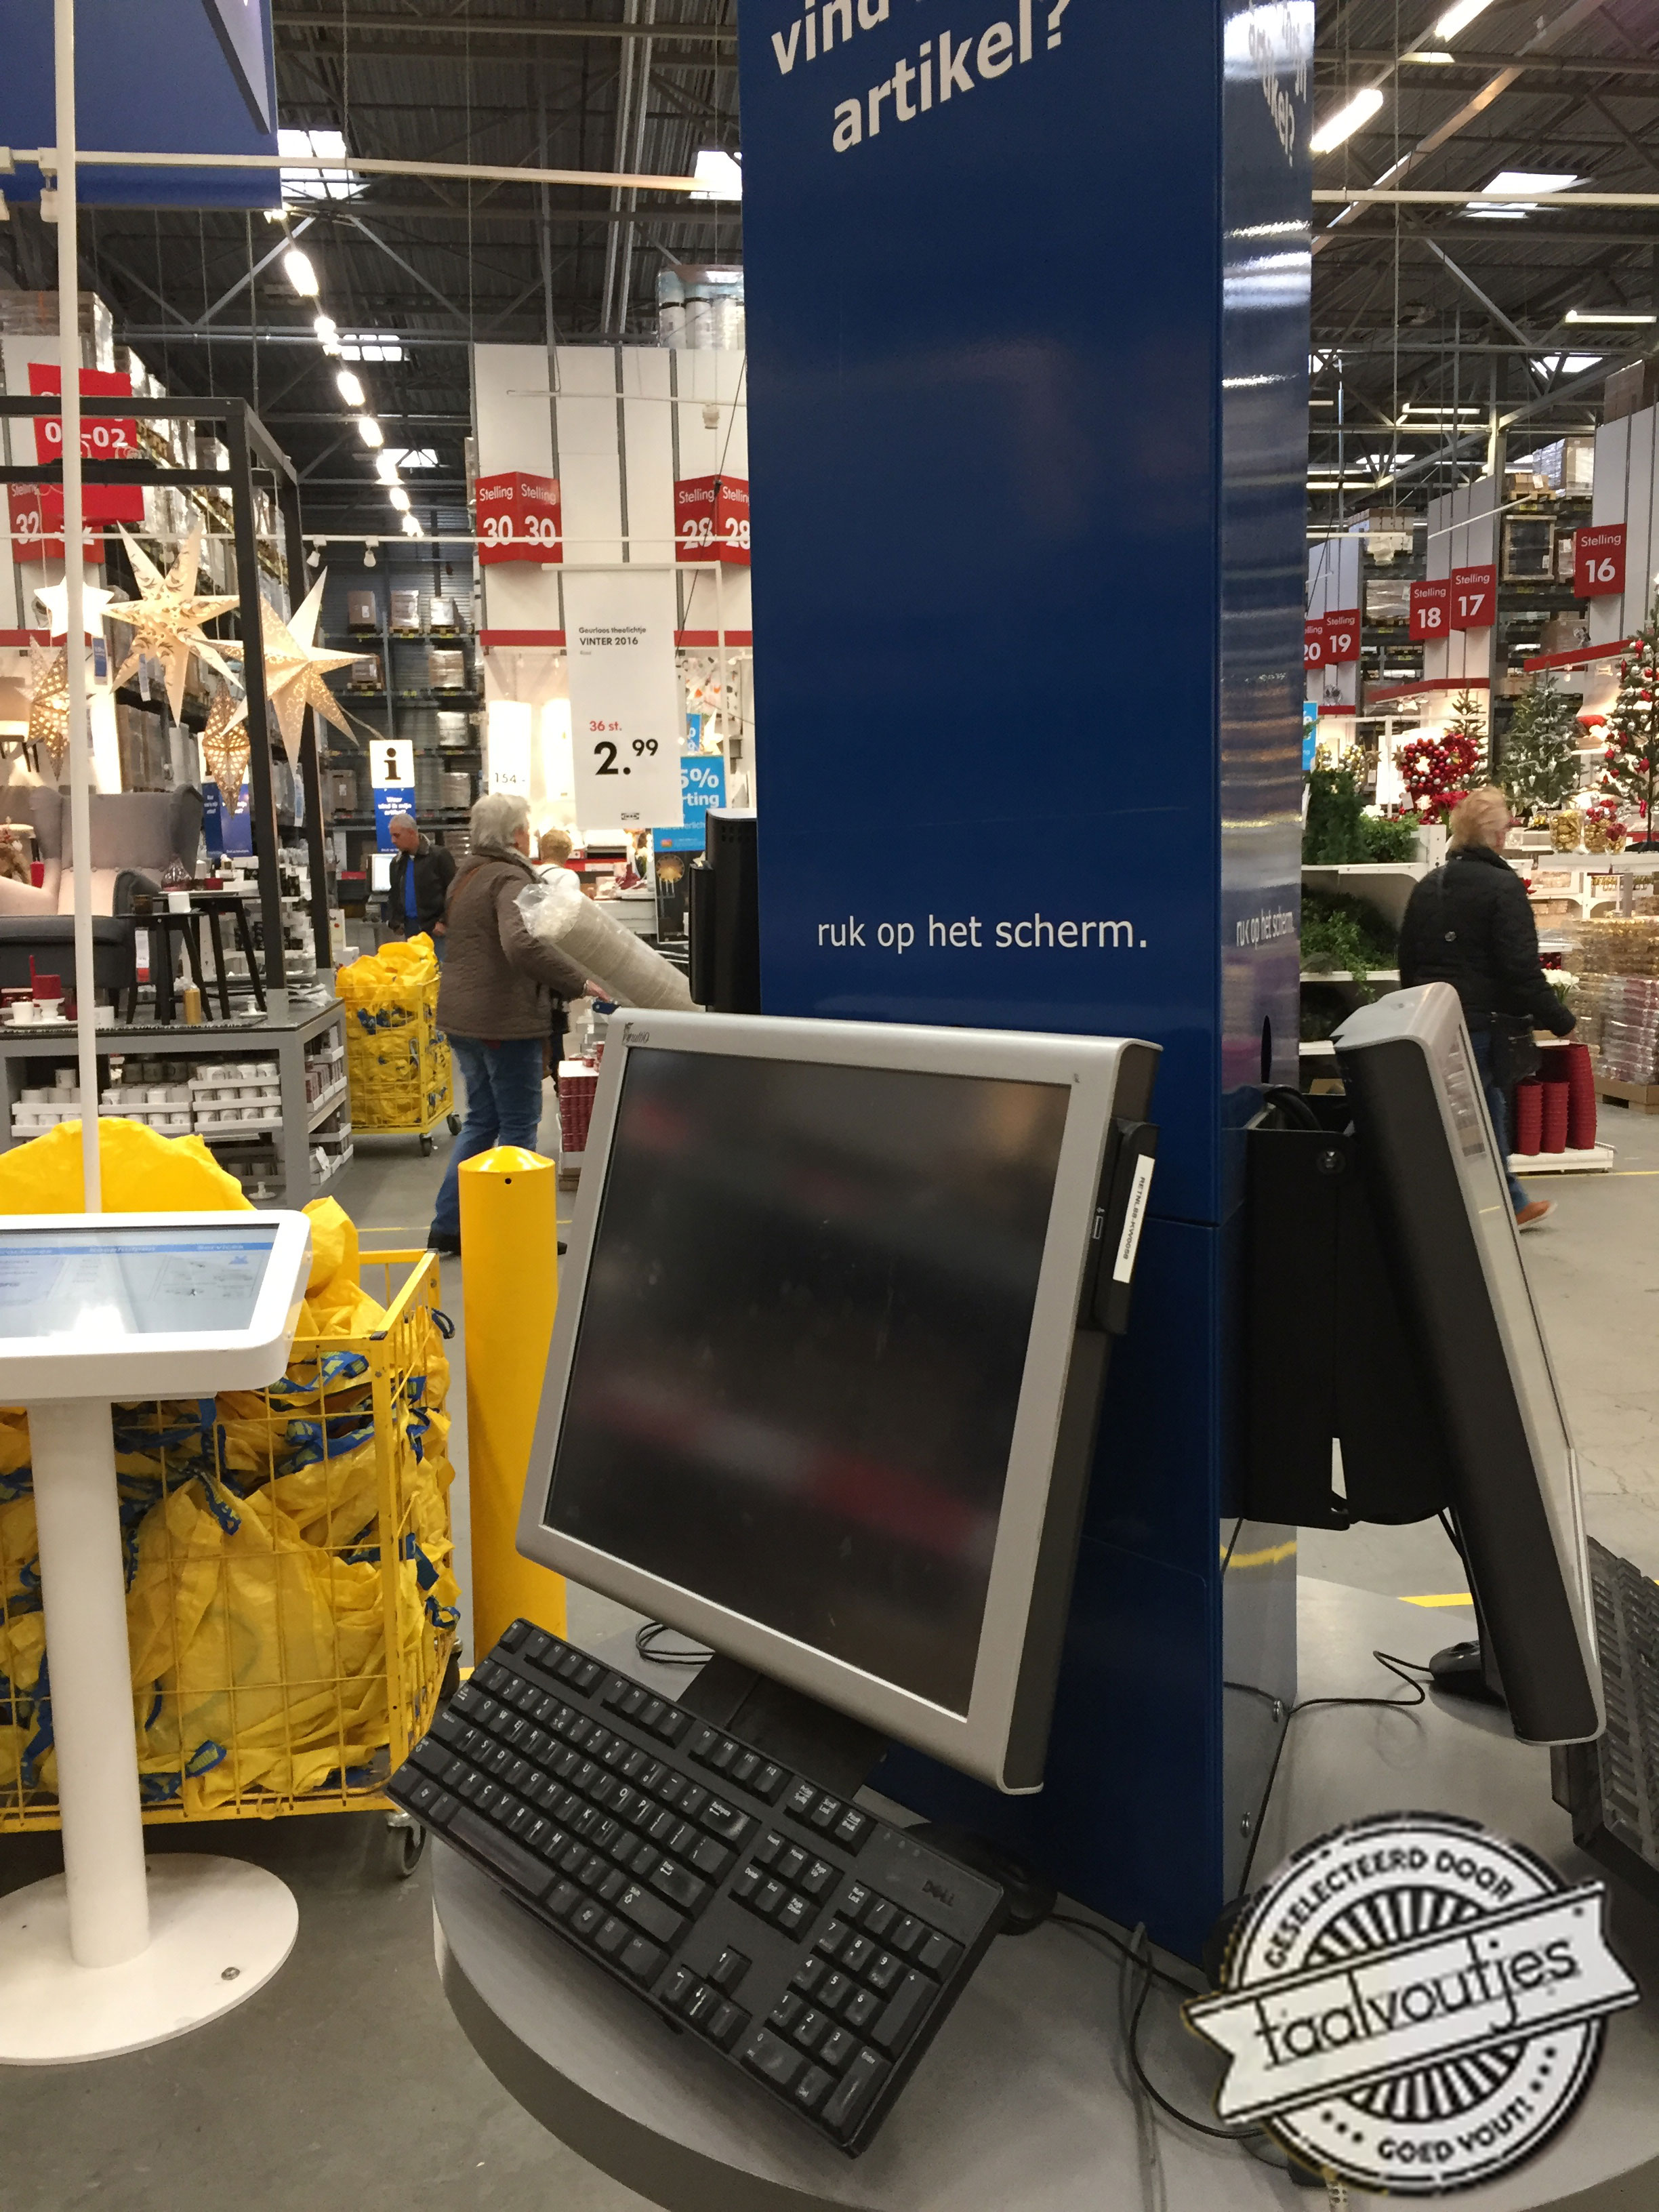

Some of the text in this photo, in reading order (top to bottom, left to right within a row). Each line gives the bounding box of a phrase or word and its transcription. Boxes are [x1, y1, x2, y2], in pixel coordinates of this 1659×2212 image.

[832, 0, 1070, 154] artikel?
[45, 422, 126, 448] 0-02
[479, 485, 513, 503] Stelling
[520, 483, 557, 505] Stelling
[678, 487, 715, 505] Stelling
[483, 515, 514, 549] 30
[524, 515, 556, 549] 30
[682, 517, 714, 550] 28
[1580, 533, 1622, 548] Stelling
[1455, 573, 1490, 586] Stelling
[1584, 558, 1616, 583] 16
[1414, 587, 1446, 598] Stelling
[1458, 594, 1486, 616] 17
[1326, 617, 1355, 626] Stelling
[1417, 607, 1441, 629] 18
[579, 637, 638, 646] VINTER 2016
[1329, 634, 1351, 653] 19
[589, 720, 622, 732] 36 st.
[817, 913, 1147, 954] ruk op het scherm.
